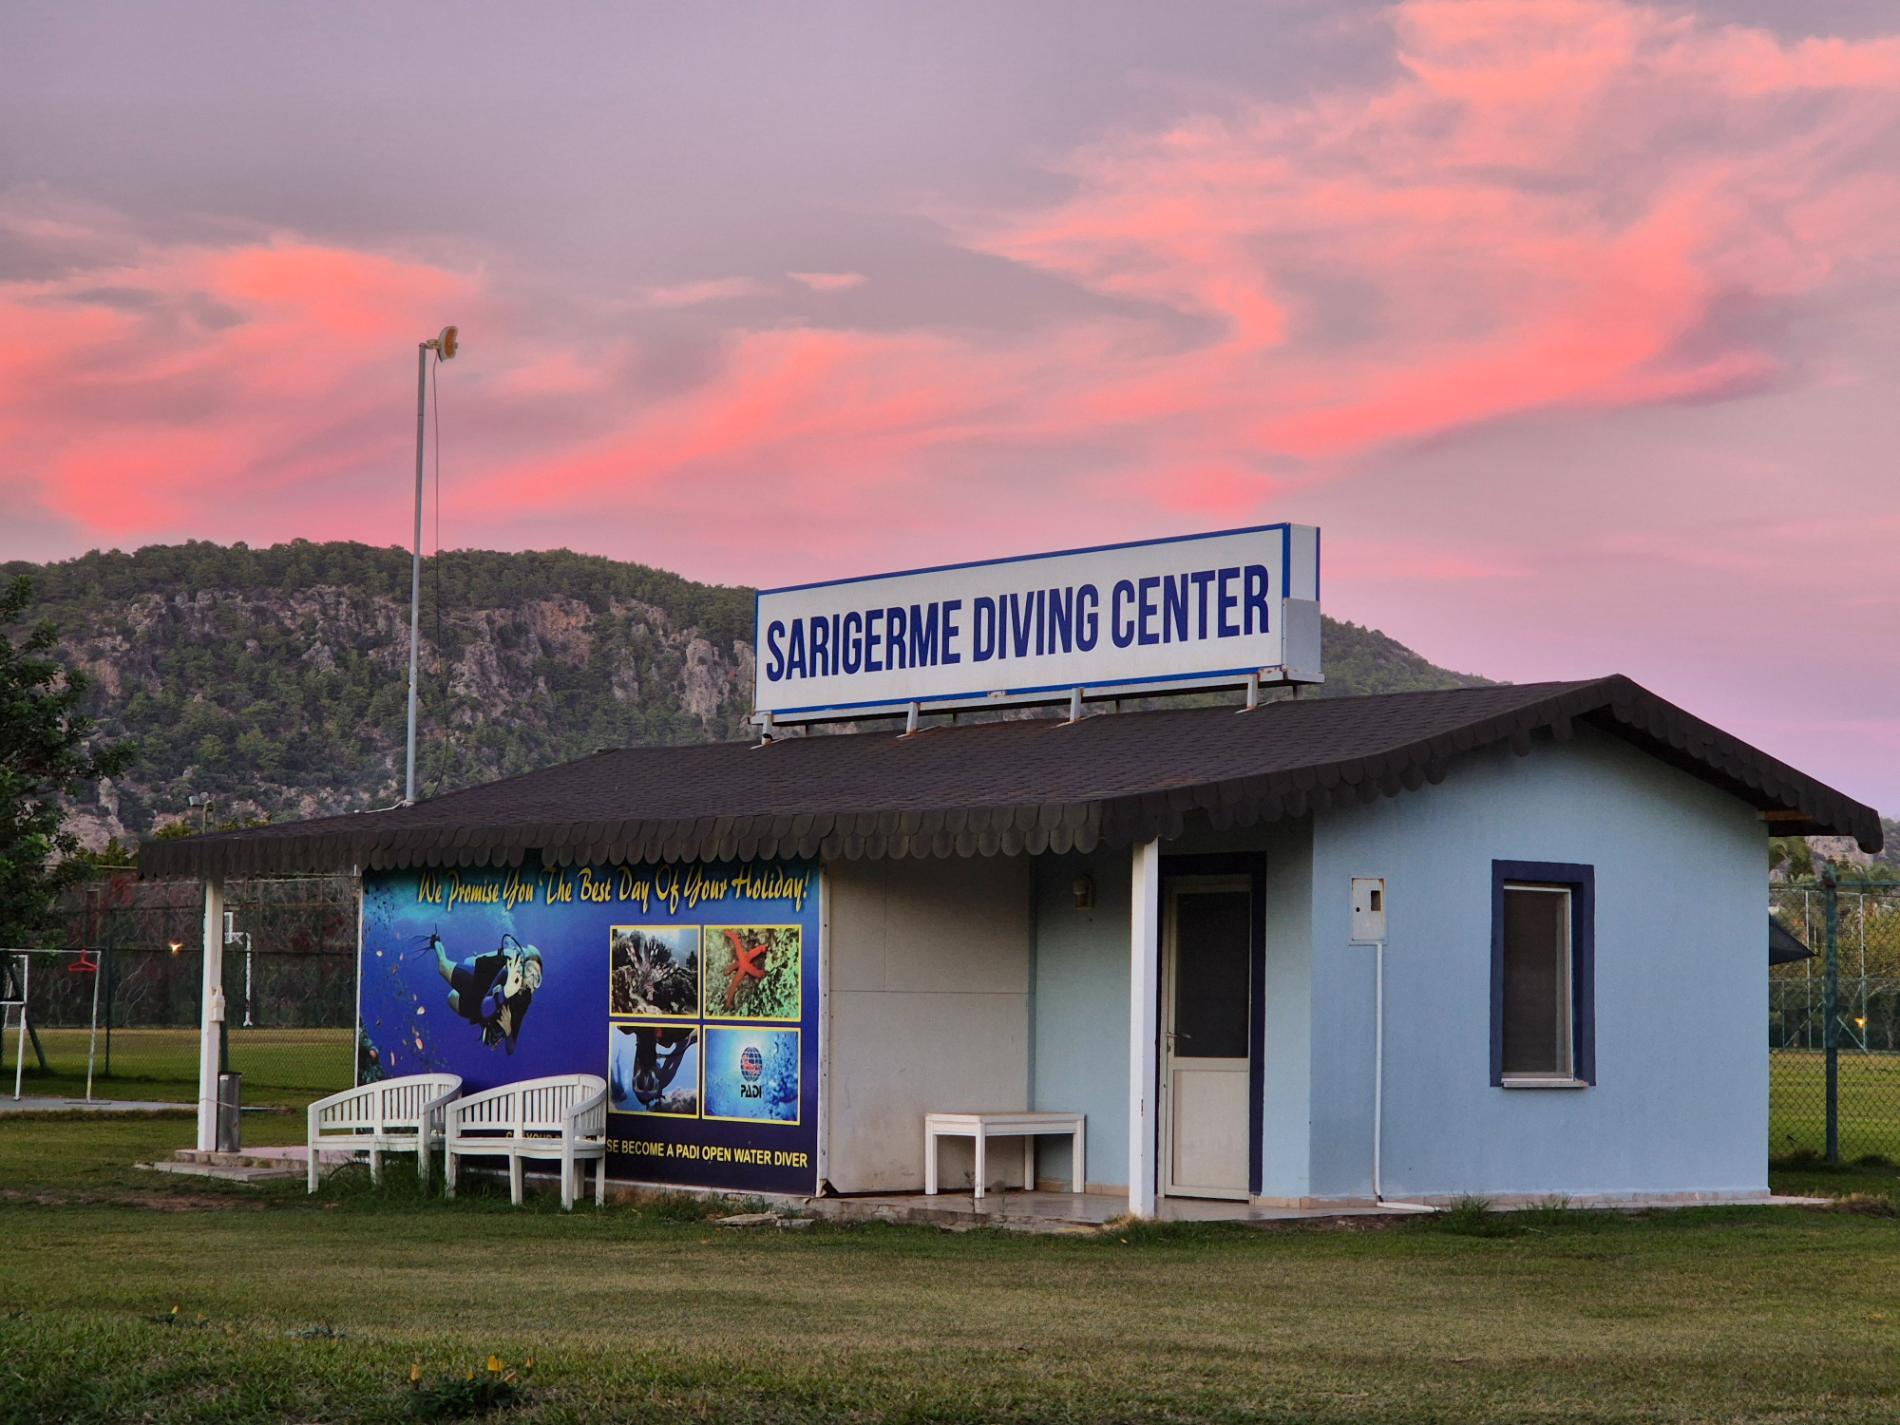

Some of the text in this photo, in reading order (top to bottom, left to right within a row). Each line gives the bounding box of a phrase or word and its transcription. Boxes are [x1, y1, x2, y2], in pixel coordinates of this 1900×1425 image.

[766, 564, 1270, 682] SARIGERME DIVING CENTER
[418, 864, 810, 915] We Promise You The Best Day Of Your Holiday!
[740, 1084, 762, 1098] PADI
[621, 1139, 664, 1157] BECOME
[666, 1144, 674, 1157] A
[676, 1144, 700, 1159] PADI
[702, 1145, 731, 1162] OPEN
[733, 1148, 772, 1165] WATER
[774, 1151, 808, 1168] DIVER
